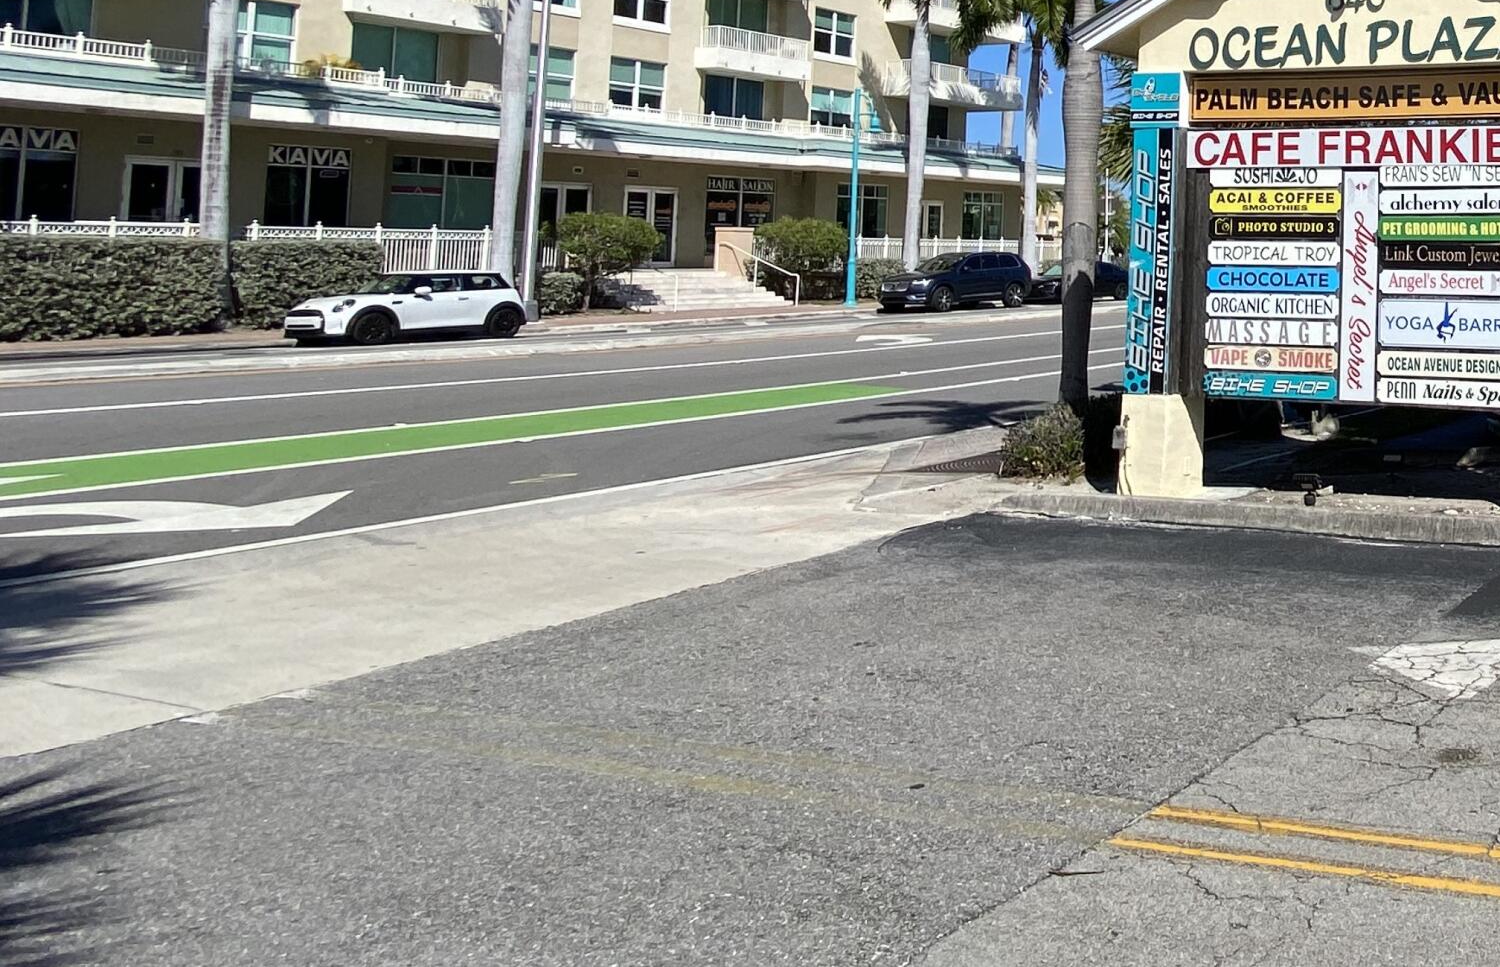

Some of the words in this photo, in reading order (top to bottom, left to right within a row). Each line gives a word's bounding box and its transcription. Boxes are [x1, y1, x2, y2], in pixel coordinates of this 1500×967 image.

[1189, 22, 1347, 70] OCEAN
[1195, 88, 1258, 111] PALM
[1267, 86, 1349, 110] BEACH
[1358, 84, 1420, 108] SAFE
[1431, 83, 1448, 106] &
[268, 146, 350, 166] KAVA
[1194, 131, 1301, 166] CAFE
[1158, 148, 1172, 205] SALES
[1234, 168, 1273, 184] SUSHI
[1299, 168, 1318, 184] JO
[1385, 166, 1429, 182] FRAN'S
[1432, 166, 1462, 182] SEW
[708, 178, 736, 190] HAIR
[743, 181, 774, 191] SALON
[1134, 148, 1156, 252] SHOP
[1216, 193, 1251, 204] ACAI
[1258, 193, 1267, 204] &
[1274, 192, 1334, 204] COFFEE
[1390, 193, 1462, 212] alchemy
[1237, 222, 1276, 232] PHOTO
[1280, 222, 1324, 232] STUDIO
[1327, 222, 1334, 233] 3
[1382, 222, 1402, 235] PET
[1404, 222, 1467, 235] GROOMING
[1469, 224, 1478, 235] &
[1155, 214, 1169, 291] RENTAL
[1213, 246, 1288, 261] TROPICAL
[1294, 246, 1336, 262] TROY
[1384, 244, 1414, 262] Link
[1417, 245, 1466, 262] Custom
[1218, 272, 1329, 287] CHOCOLATE
[1388, 272, 1437, 292] Angel's
[1440, 273, 1484, 290] Secret
[1211, 297, 1270, 314] ORGANIC
[1275, 298, 1333, 315] KITCHEN
[1129, 269, 1151, 372] BIKE
[1386, 316, 1434, 330] YOGA
[1152, 305, 1166, 373] REPAIR
[1207, 320, 1332, 345] MASSAGE
[1211, 349, 1248, 366] VAPE
[1278, 350, 1333, 368] SMOKE
[1388, 357, 1421, 372] OCEAN
[1423, 358, 1463, 373] AVENUE
[1210, 377, 1266, 393] BIKE
[1273, 381, 1330, 395] SHOP
[1423, 384, 1463, 400] Nails
[1465, 391, 1474, 399] &
